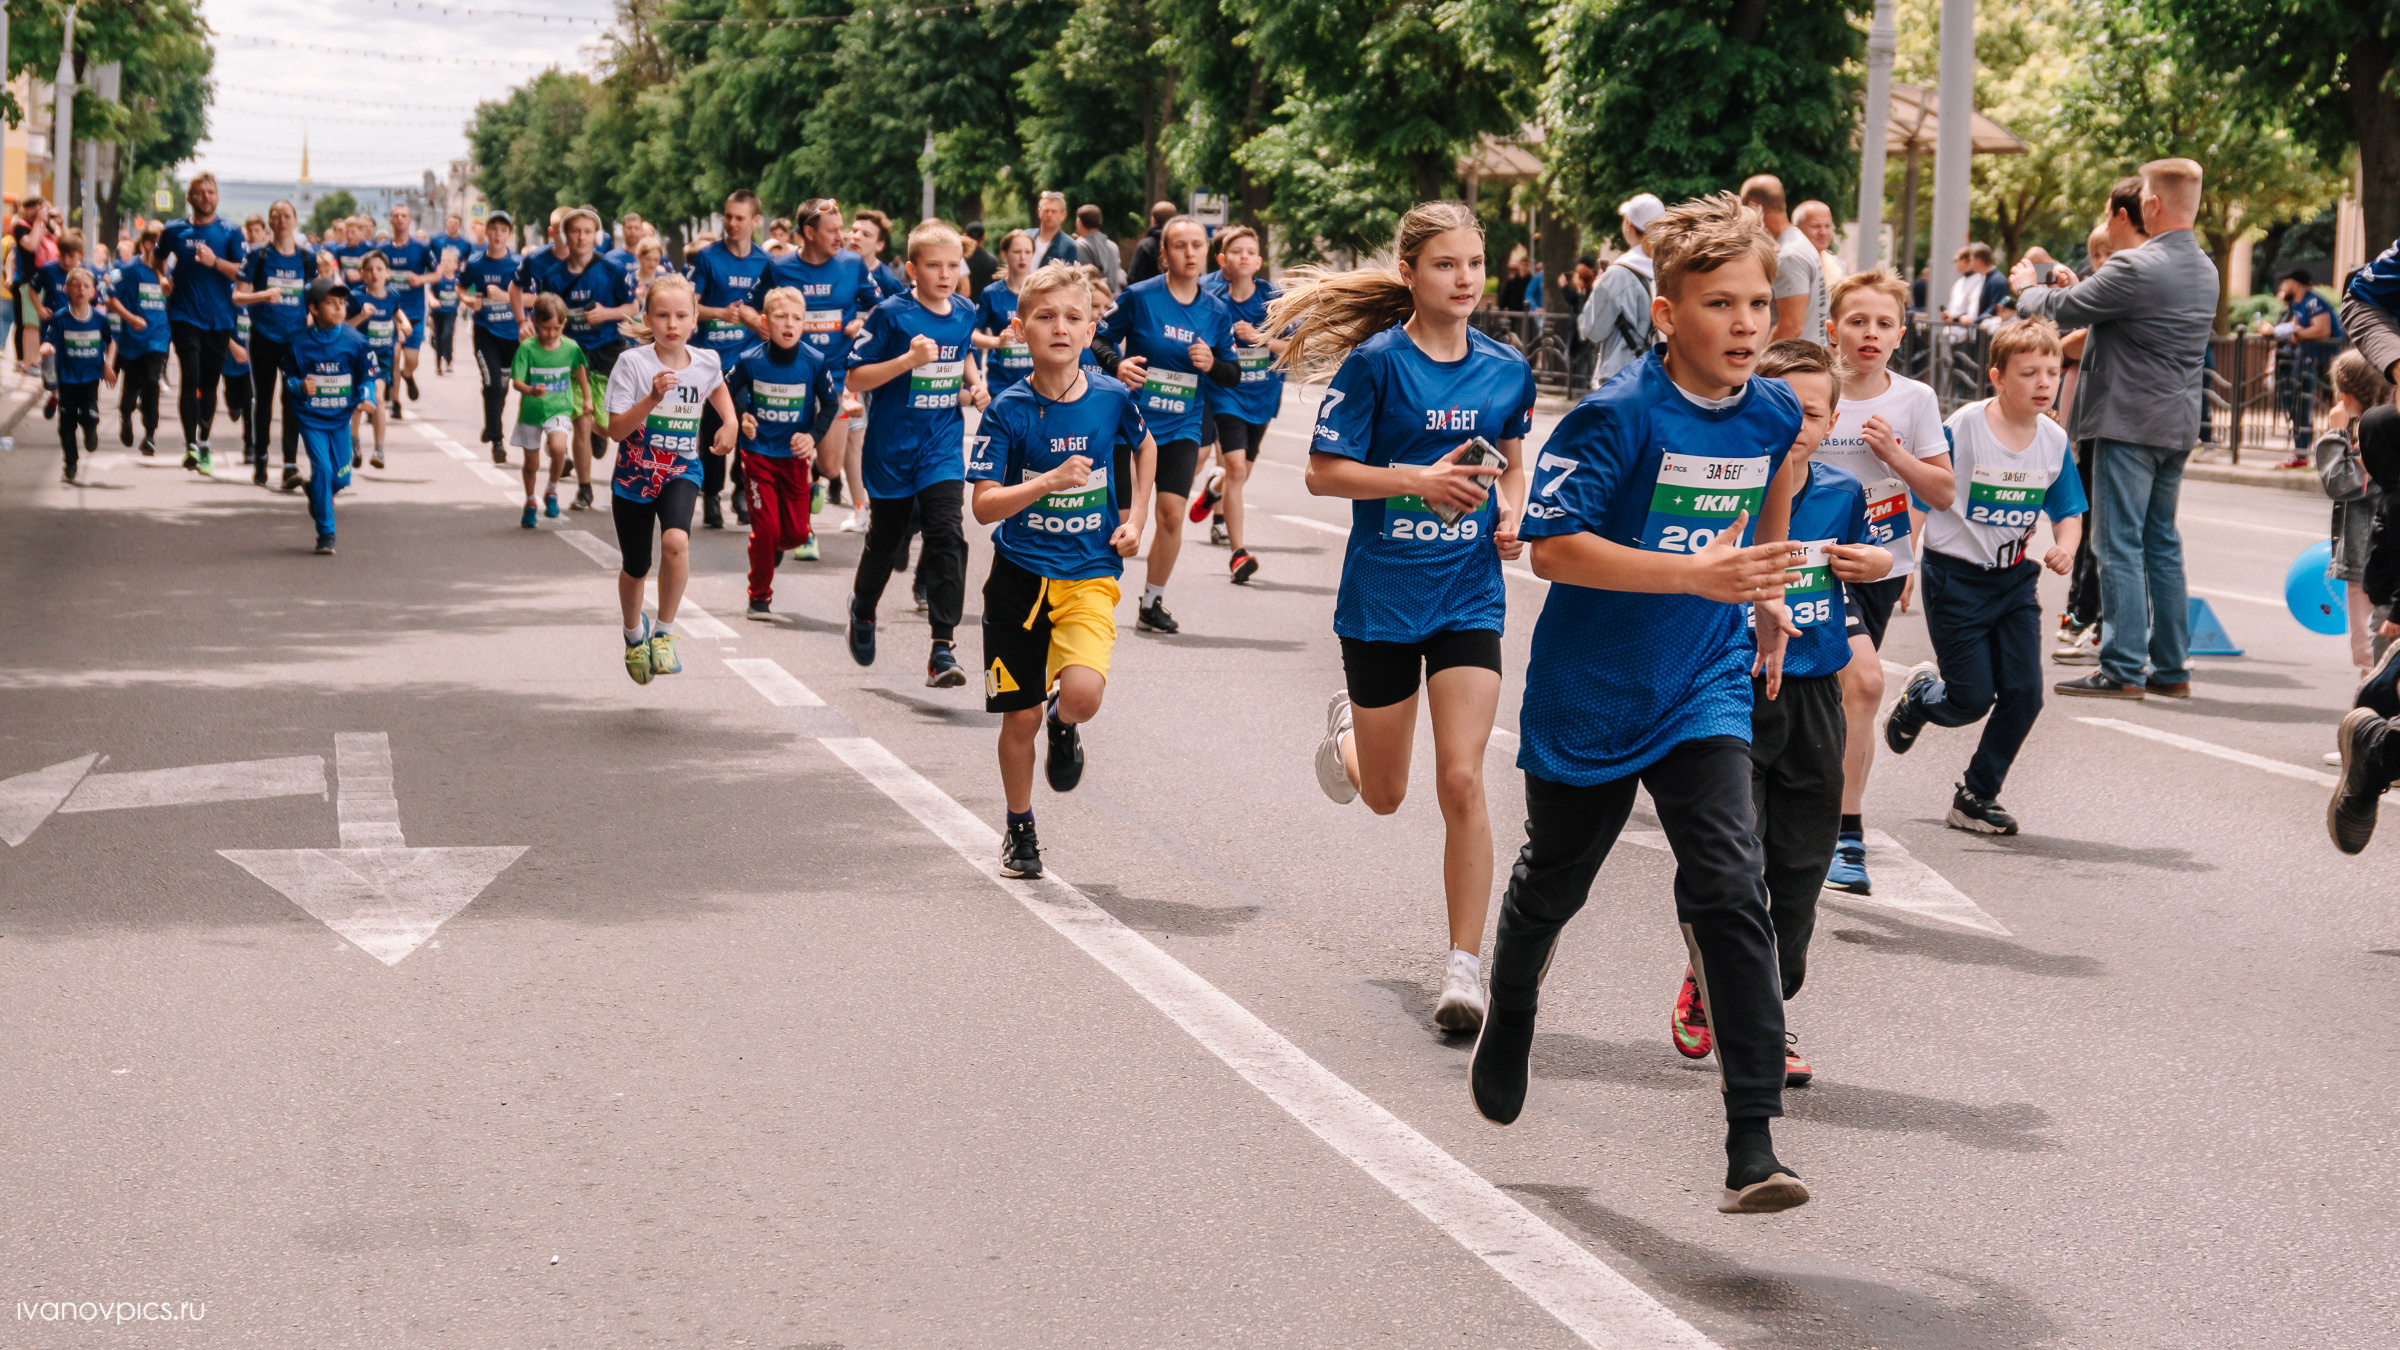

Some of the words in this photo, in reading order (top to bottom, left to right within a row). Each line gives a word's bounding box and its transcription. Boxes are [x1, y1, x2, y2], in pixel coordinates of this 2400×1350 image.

[809, 333, 830, 345] 79
[1240, 370, 1267, 382] 233
[1148, 395, 1186, 413] 2116
[1320, 387, 1346, 419] 7
[757, 408, 800, 422] 2057
[1425, 409, 1447, 431] ЗА
[1451, 409, 1479, 431] БЕГ
[1314, 424, 1340, 442] 023
[973, 435, 992, 459] 7
[1050, 437, 1066, 453] ЗА
[1068, 436, 1088, 451] БЕГ
[1538, 451, 1580, 498] 7
[1048, 495, 1085, 508] 1KM
[1864, 487, 1873, 500] ЕГ
[1995, 489, 2027, 501] 1KM
[1693, 494, 1741, 512] 1KM
[1869, 501, 1892, 518] KM
[1027, 513, 1102, 533] 2008
[1971, 506, 2036, 526] 2409
[1391, 518, 1479, 542] 2039
